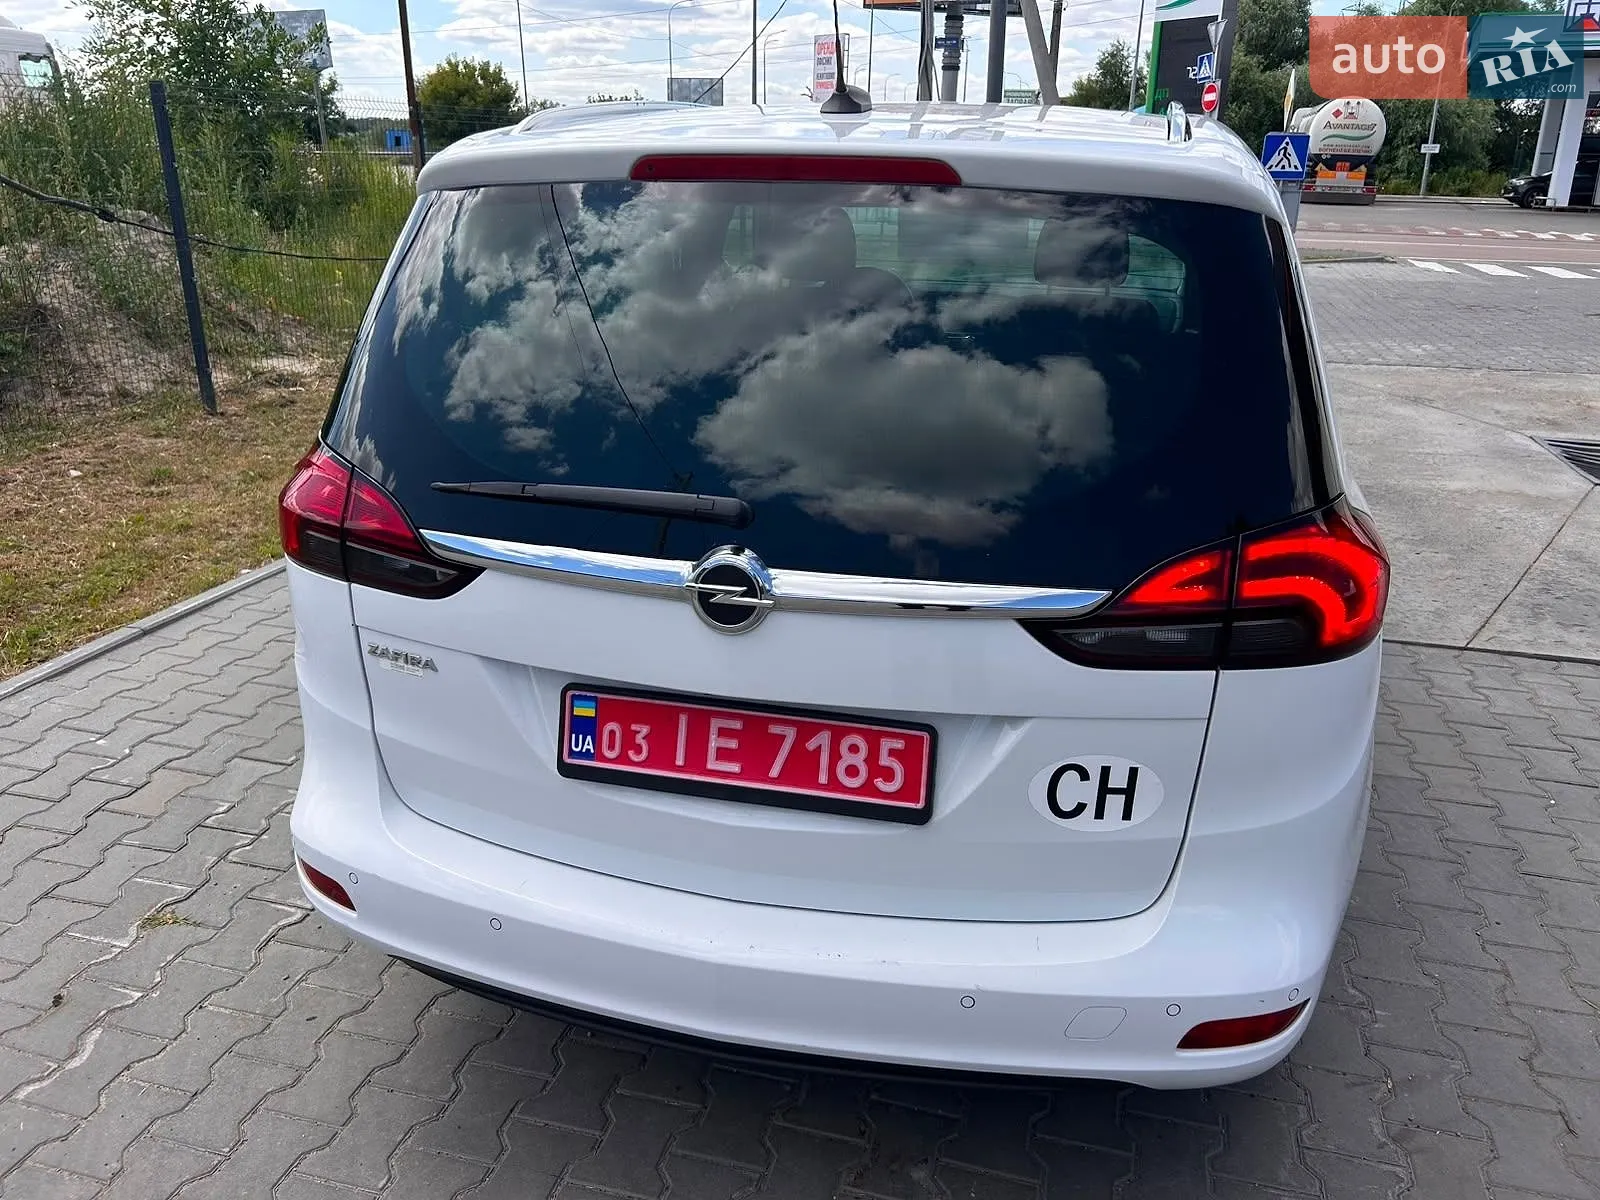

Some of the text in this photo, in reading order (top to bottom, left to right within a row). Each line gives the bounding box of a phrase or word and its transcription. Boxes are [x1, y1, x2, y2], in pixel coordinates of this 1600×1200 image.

[367, 642, 439, 672] ZAFIRA
[571, 733, 595, 754] UA
[601, 721, 651, 763] 03
[767, 724, 906, 793] 7185
[1046, 762, 1140, 821] CH
